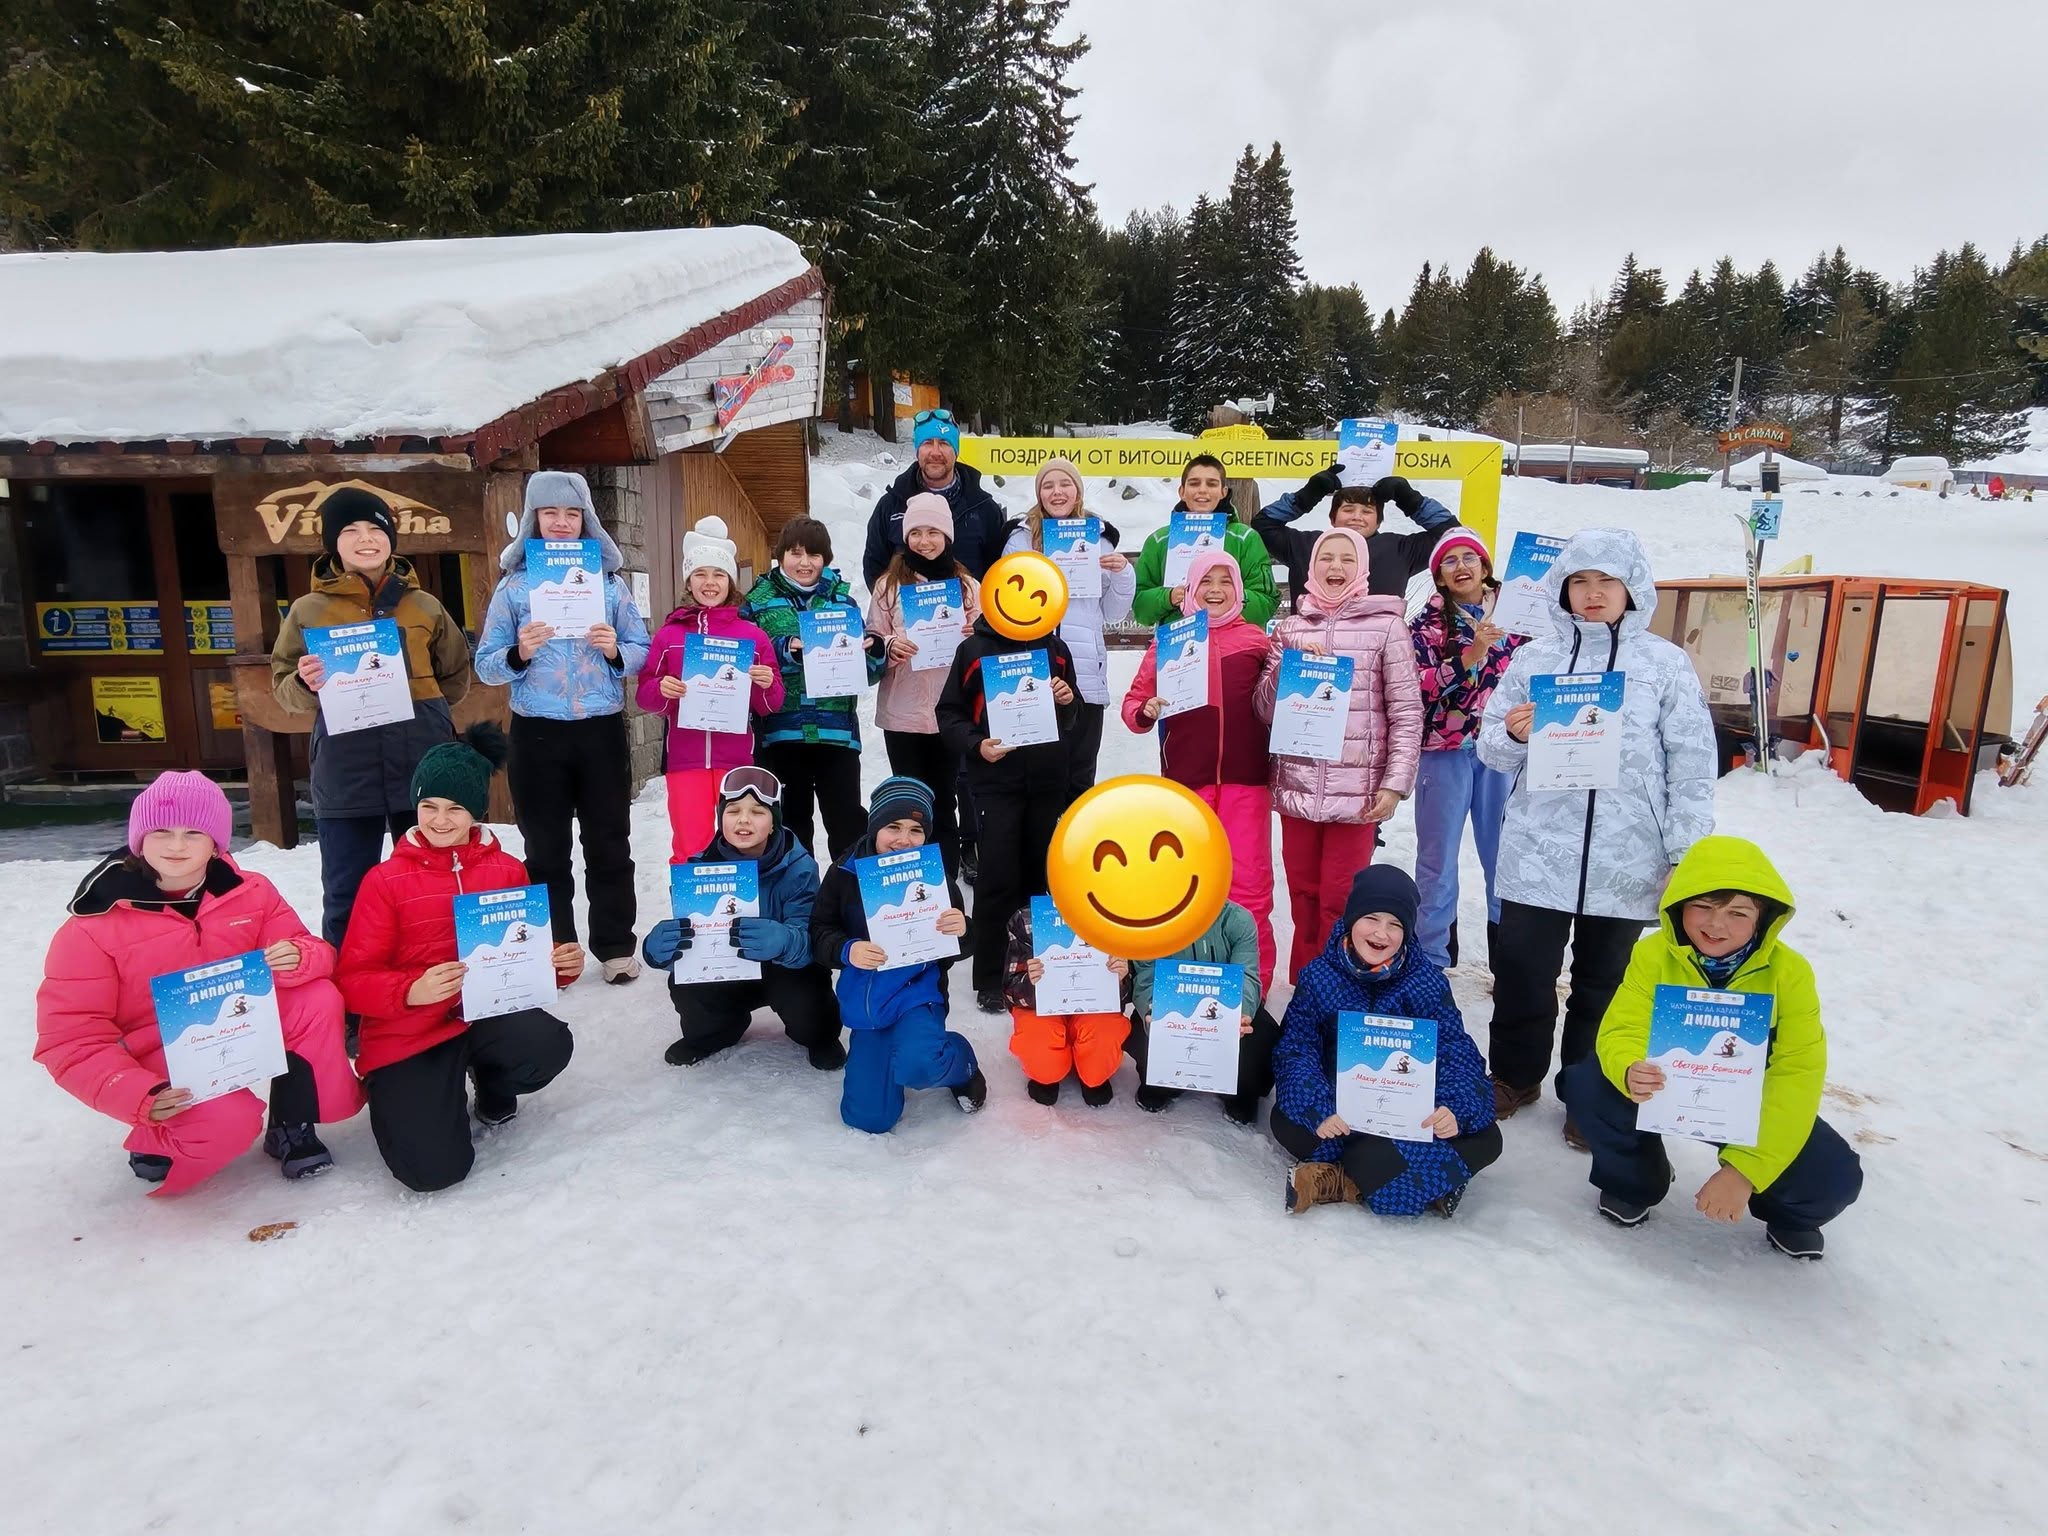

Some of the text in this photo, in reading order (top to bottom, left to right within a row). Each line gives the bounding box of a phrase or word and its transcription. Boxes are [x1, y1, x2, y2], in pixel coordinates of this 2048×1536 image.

[990, 448, 1193, 466] ПОЗДРАВИ ОТ ВИТОША
[1221, 451, 1314, 467] GREETINGS
[1395, 452, 1452, 468] TOSHA
[255, 503, 452, 544] Viha
[1531, 552, 1558, 564] ДИПЛ
[1555, 693, 1600, 705] ДИПЛОМ
[882, 869, 923, 886] ДИПЛОМ
[695, 883, 736, 895] ДИПЛОМ
[482, 909, 526, 926] ДИПЛОМ
[189, 980, 245, 1005] ДИПЛОМ
[1177, 983, 1220, 996] ДИПЛОМ
[1684, 1013, 1741, 1029] ДИПЛОМ
[1363, 1035, 1412, 1050] ДИПЛОМ
